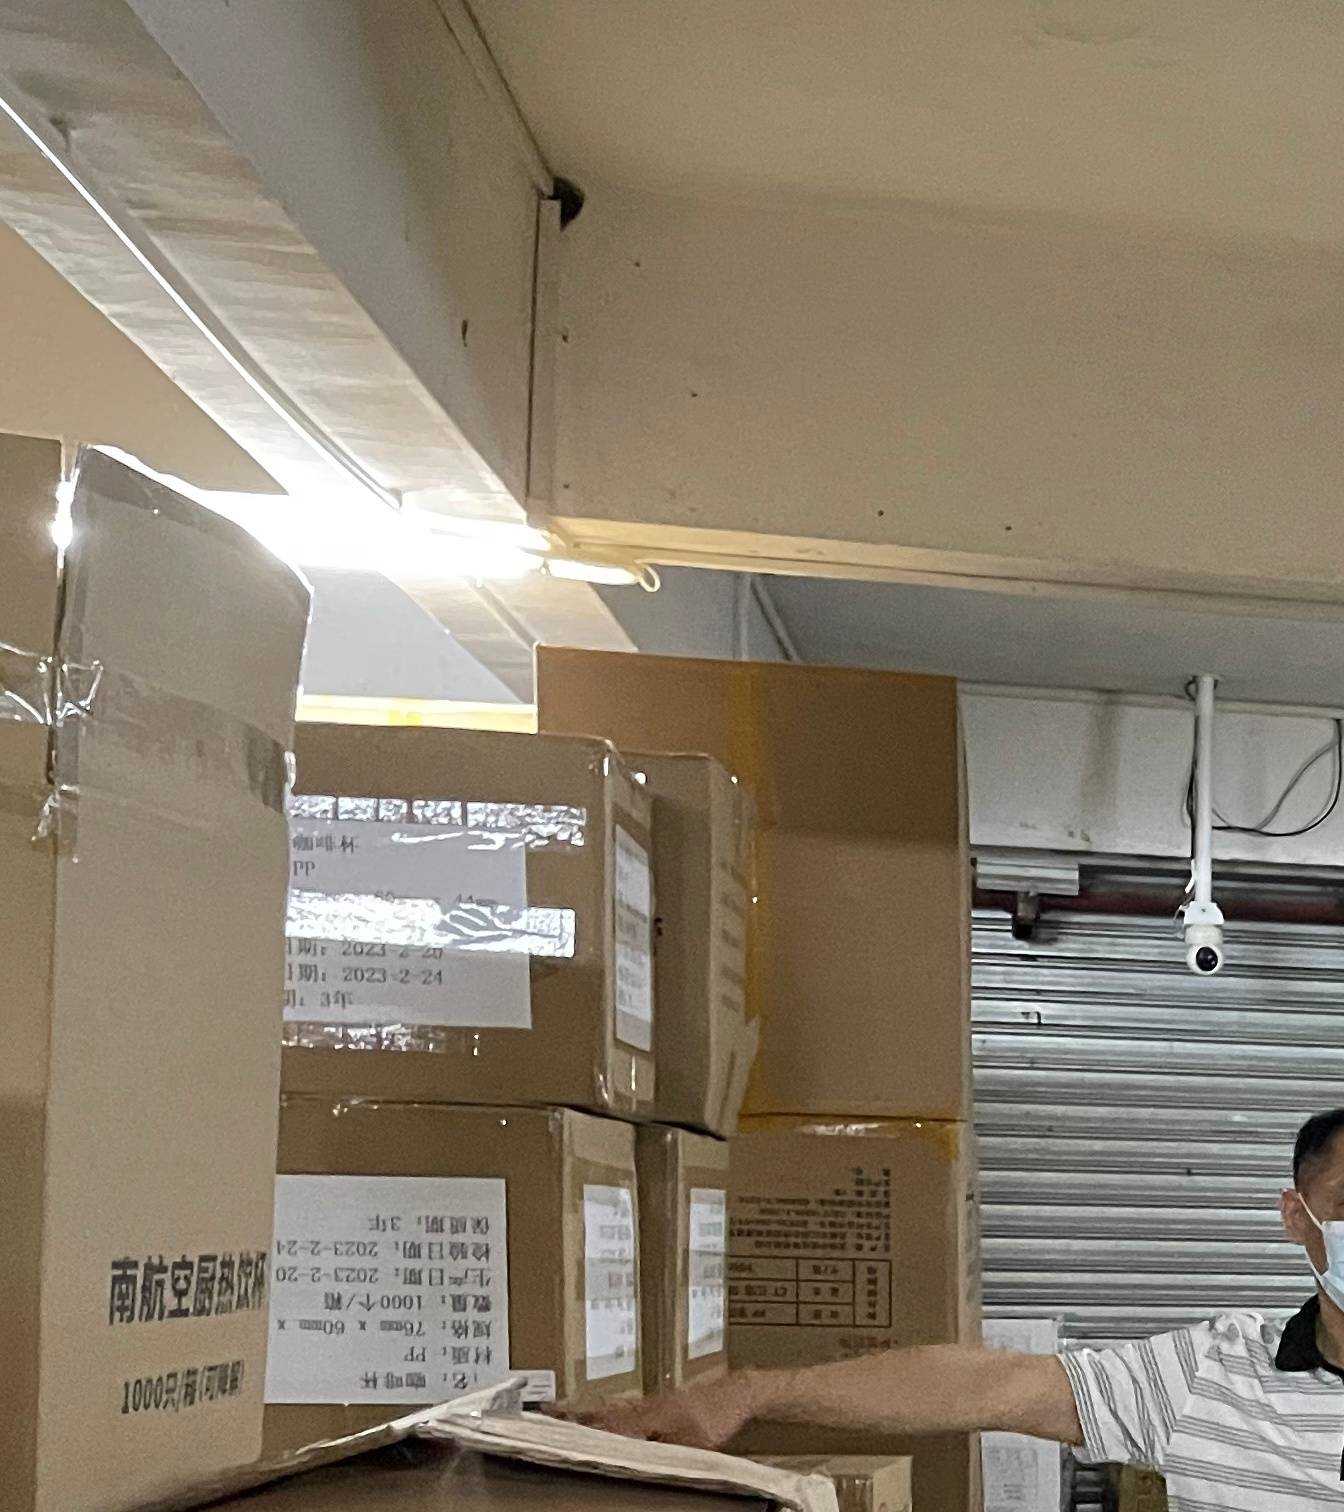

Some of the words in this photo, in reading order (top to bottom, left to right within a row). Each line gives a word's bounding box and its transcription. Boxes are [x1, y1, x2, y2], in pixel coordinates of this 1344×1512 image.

[293, 860, 316, 877] PP
[286, 964, 444, 986] 期：2023-2-24
[359, 1371, 479, 1391] 名：咖啡杯
